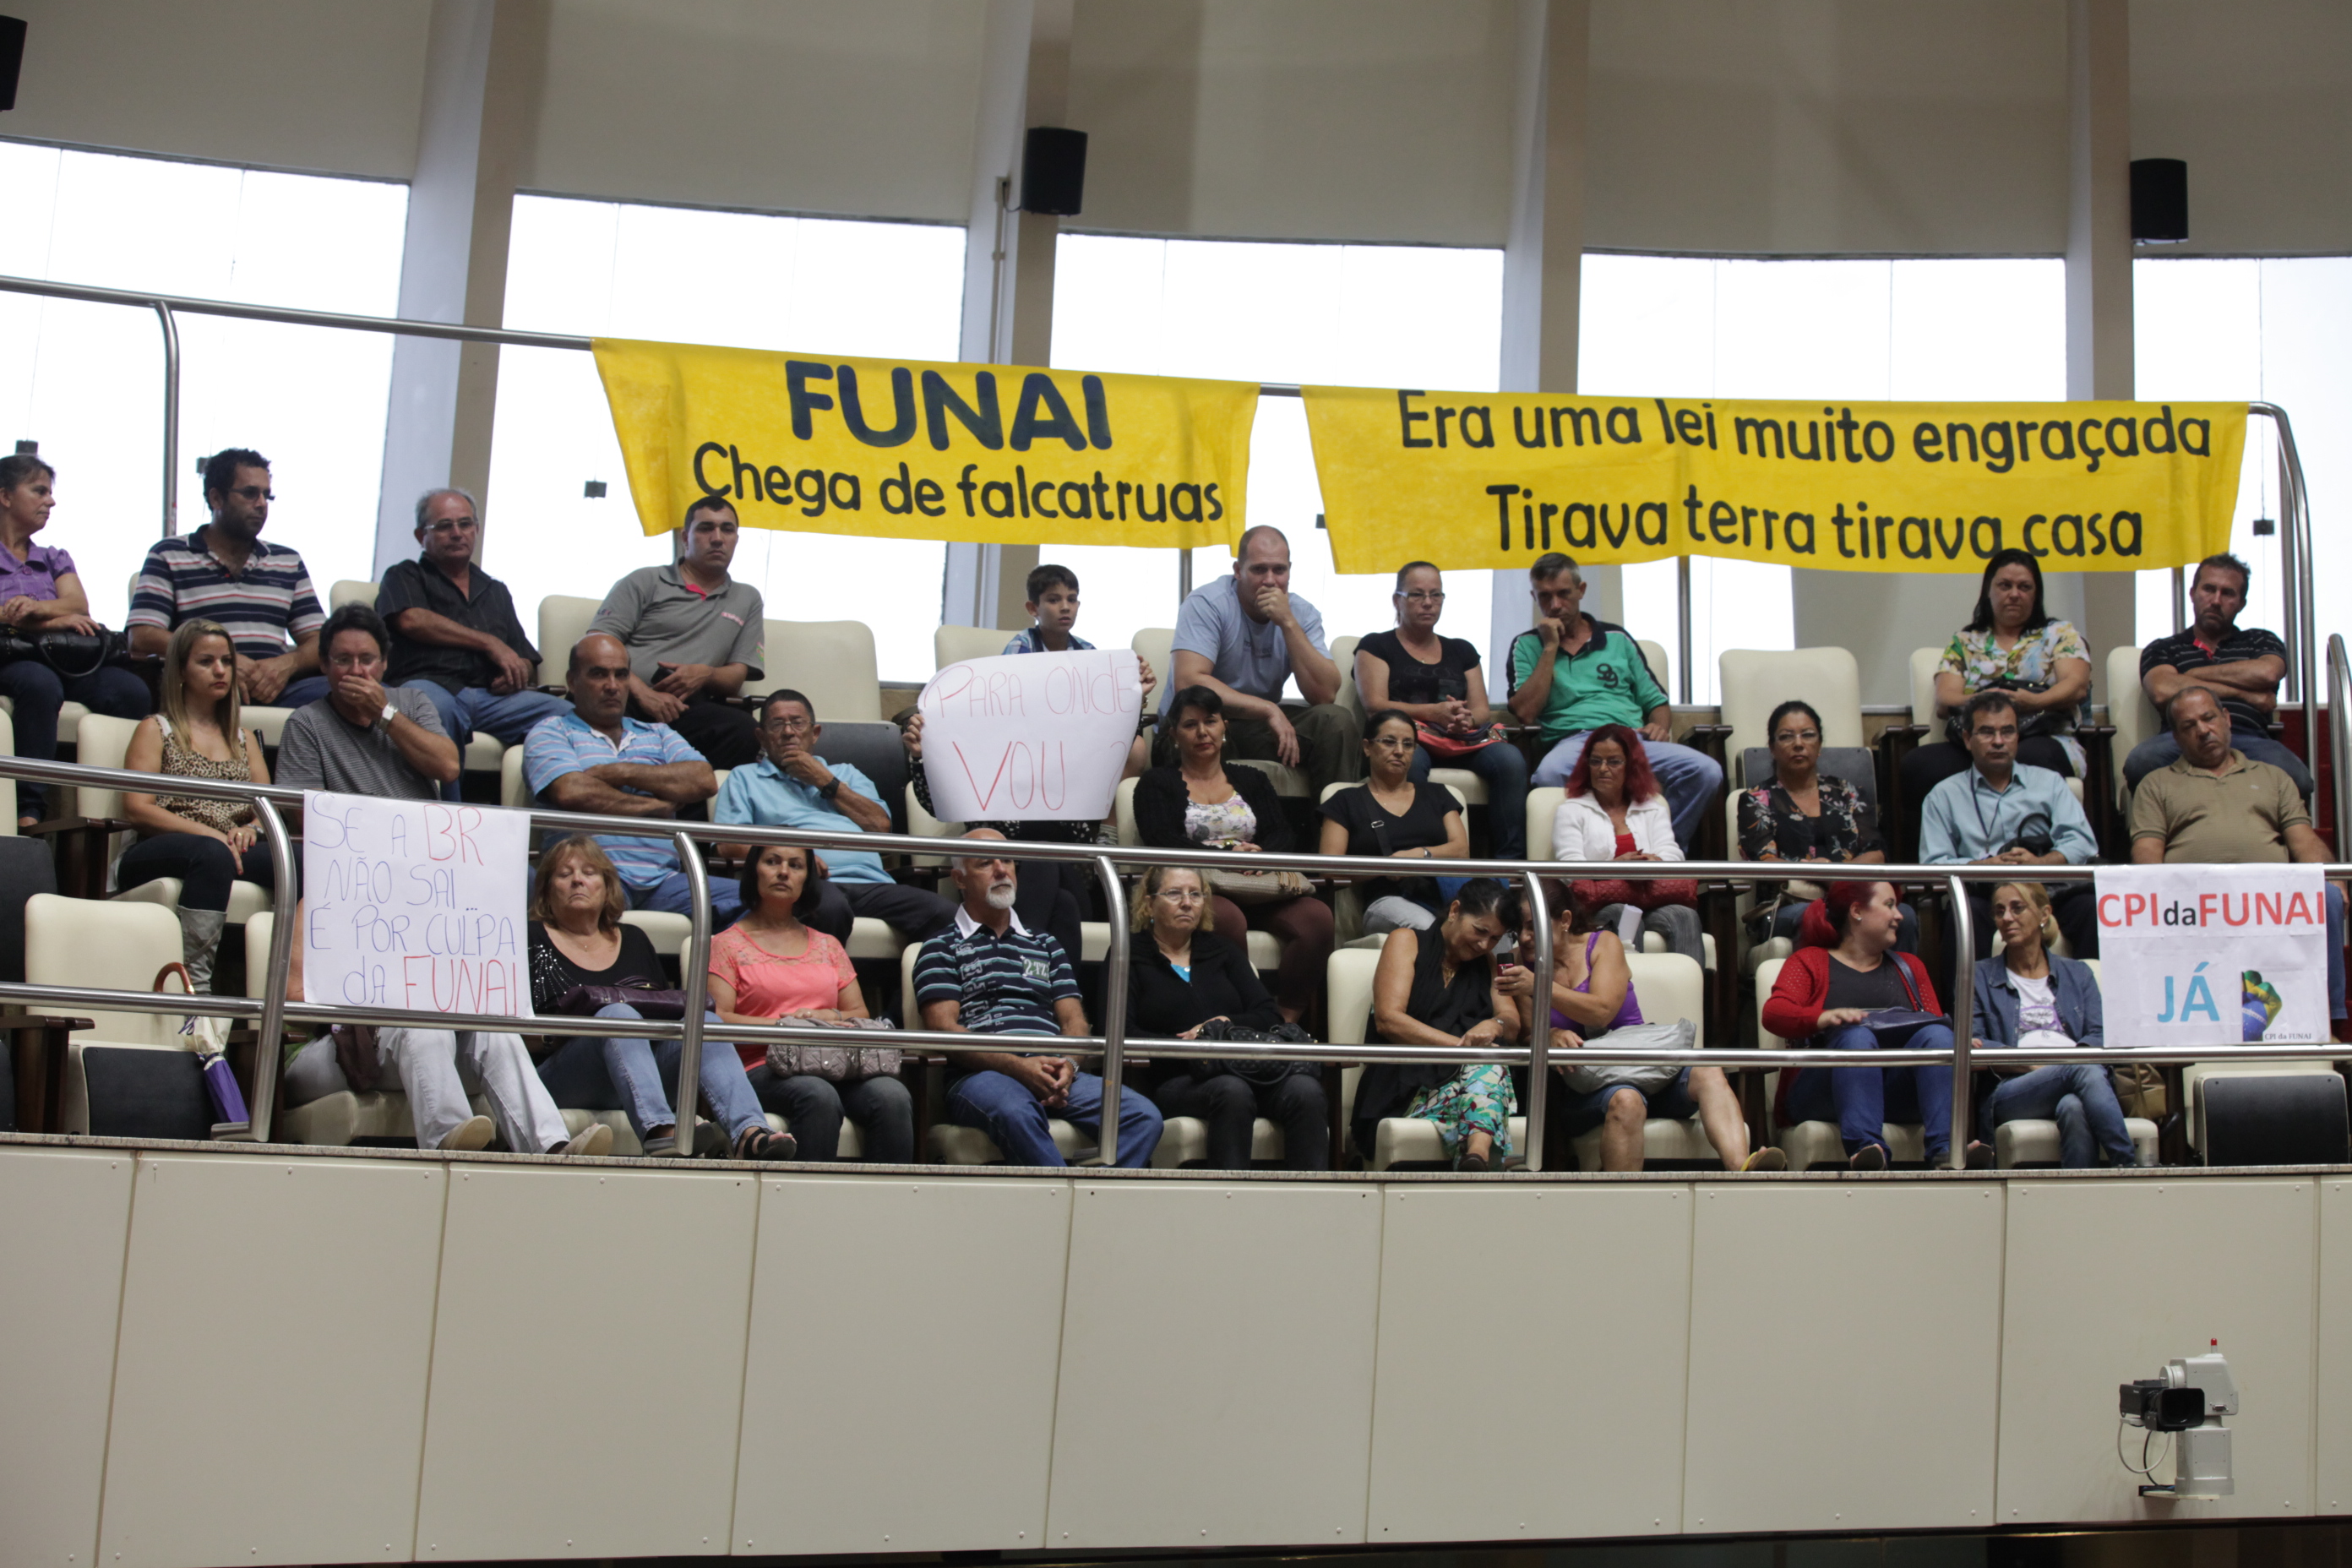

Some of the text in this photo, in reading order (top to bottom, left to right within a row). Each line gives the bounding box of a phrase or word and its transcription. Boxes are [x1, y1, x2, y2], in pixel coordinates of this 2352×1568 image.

[785, 359, 1113, 452] FUNAI
[1396, 389, 2212, 473] Era uma lei muito engraçada
[693, 441, 1223, 524] Chega de falcatruas
[1485, 484, 2142, 561] Tirava terra tirava casa
[924, 664, 1026, 718] PARA
[952, 740, 1066, 811] VOU
[309, 792, 484, 867] SE A BR
[324, 856, 392, 904] NÃO
[310, 901, 516, 956] É POR CULPA
[403, 954, 517, 1016] FUNAI
[2157, 961, 2220, 1023] JÁ
